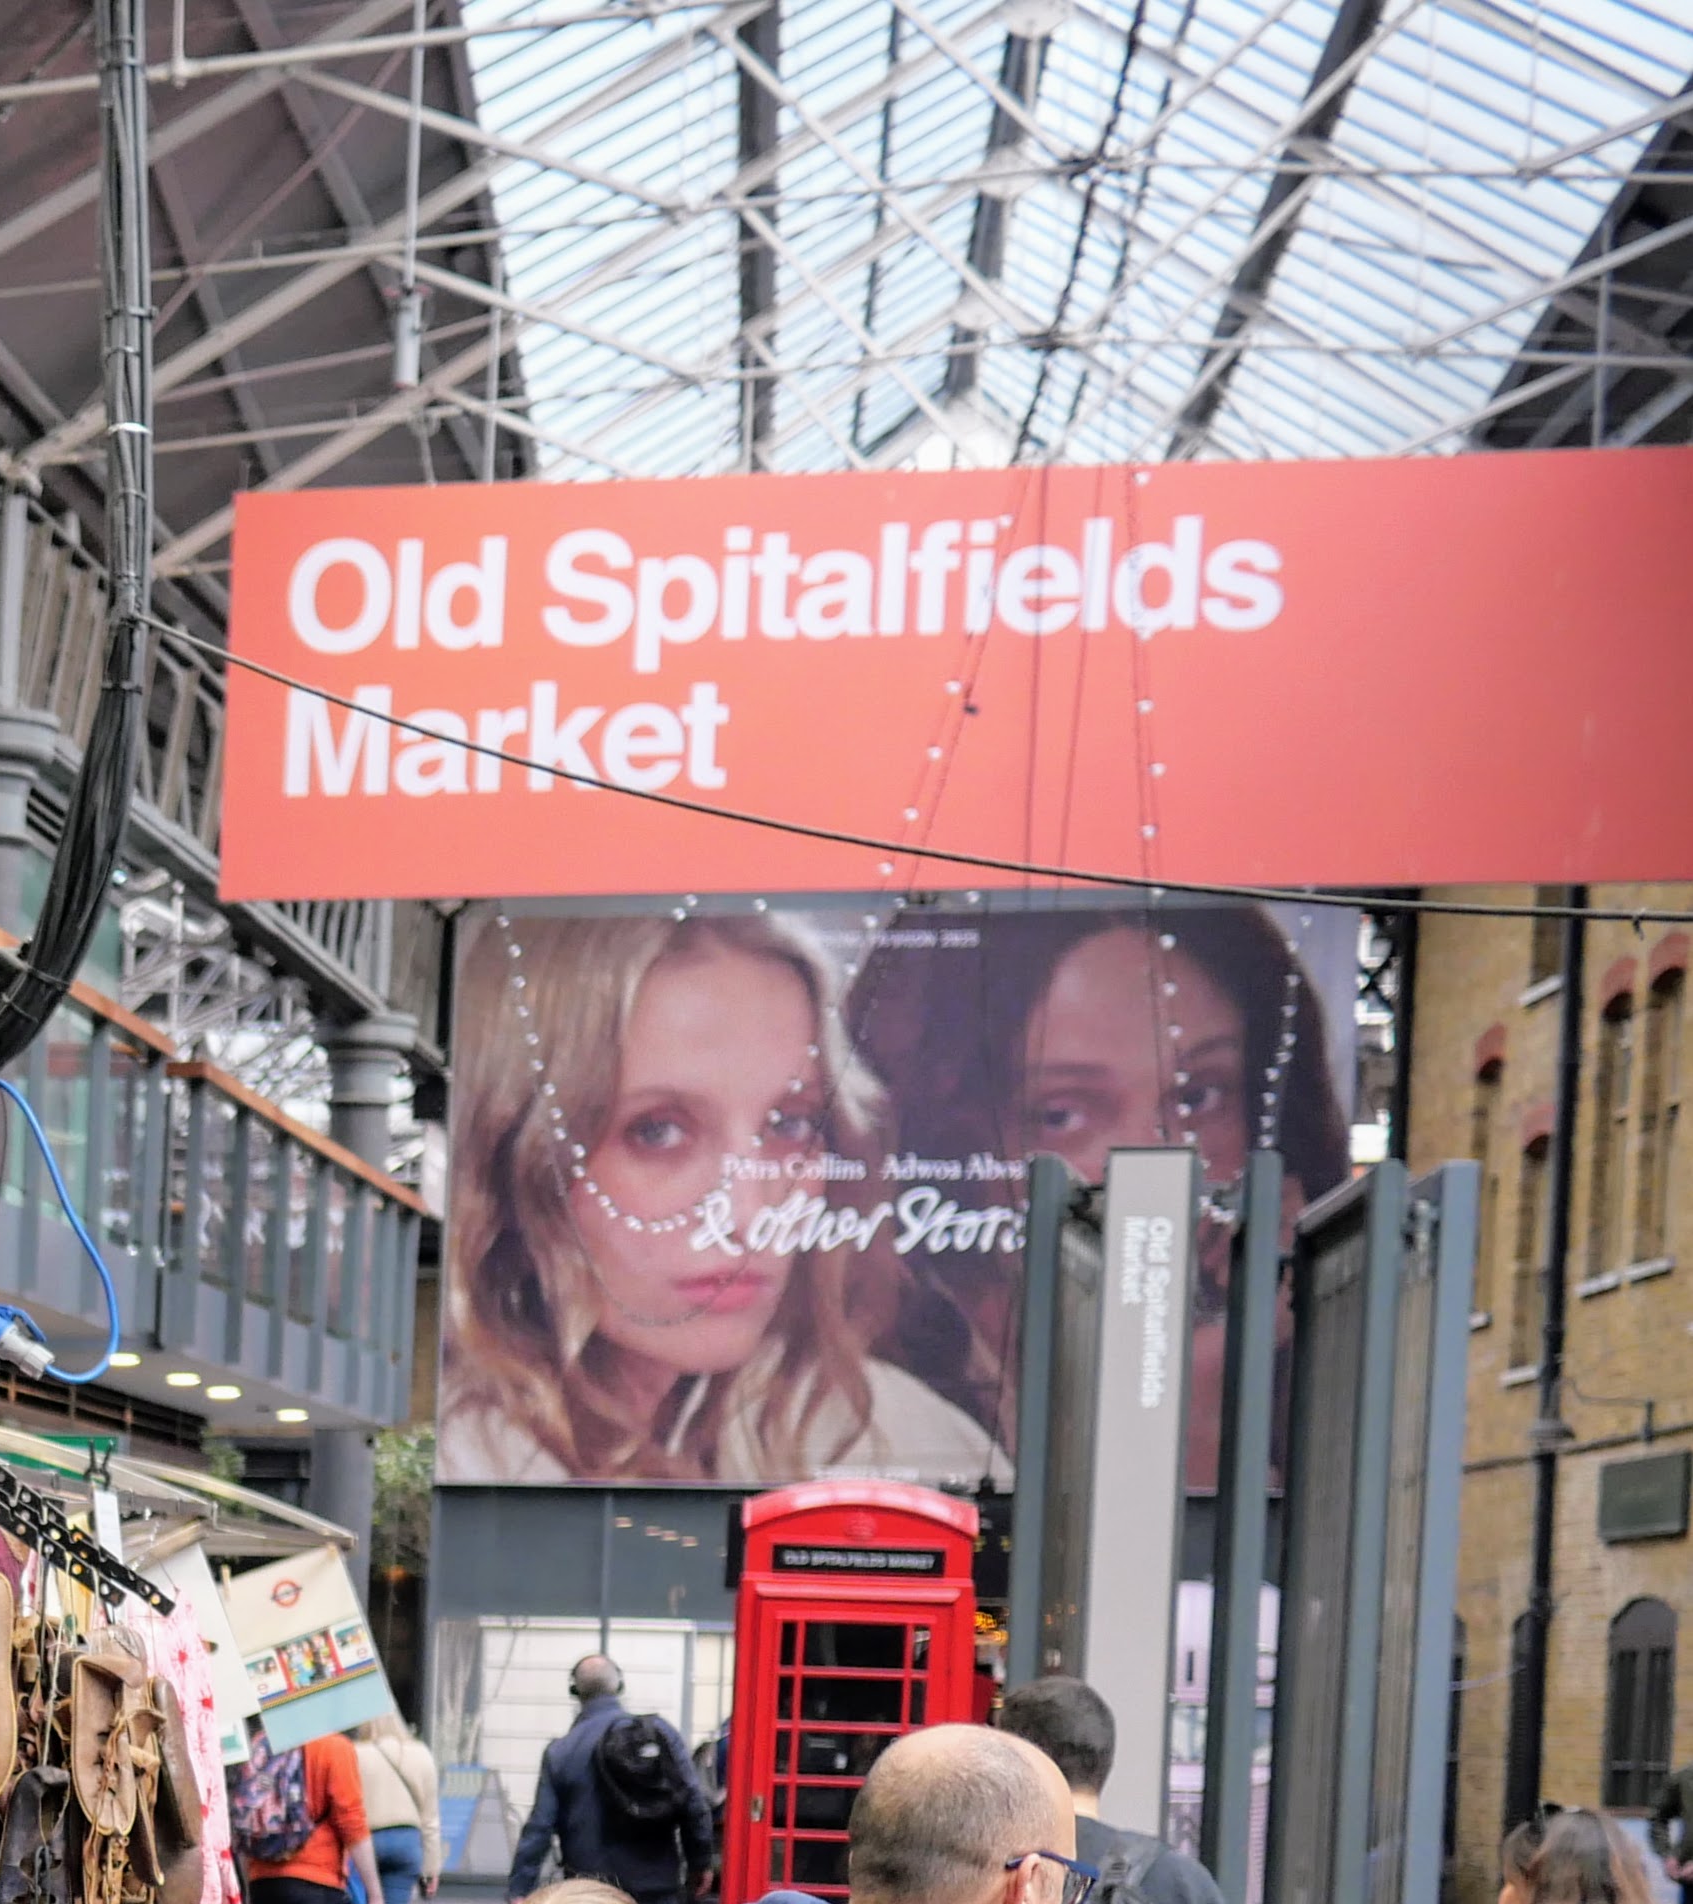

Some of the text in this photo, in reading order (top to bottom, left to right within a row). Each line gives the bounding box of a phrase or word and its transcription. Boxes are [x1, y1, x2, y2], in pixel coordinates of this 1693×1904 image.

[287, 514, 1284, 674] Old Spitalfields
[282, 680, 728, 798] Market
[722, 1153, 780, 1180] Petra
[785, 1154, 867, 1181] Collins
[882, 1153, 962, 1181] Adwoa
[690, 1188, 743, 1256] &
[746, 1189, 893, 1256] other
[1122, 1216, 1147, 1305] Market
[1141, 1216, 1174, 1409] Old Spitalfields
